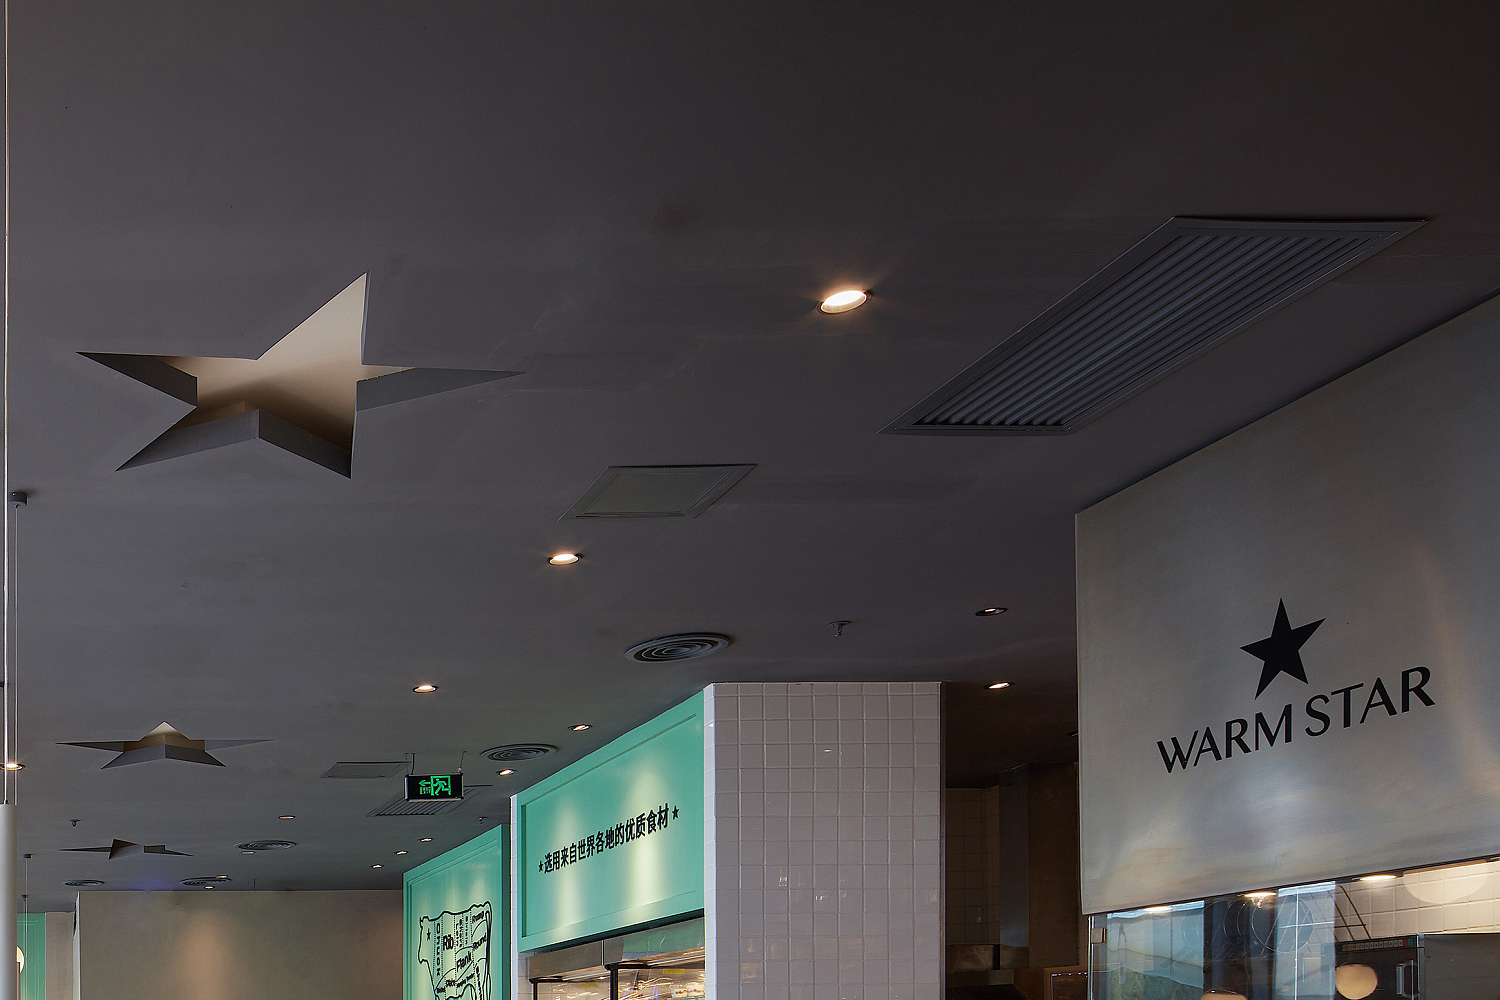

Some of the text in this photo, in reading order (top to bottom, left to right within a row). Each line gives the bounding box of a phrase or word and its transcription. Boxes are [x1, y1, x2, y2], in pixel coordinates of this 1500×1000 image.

[1156, 666, 1436, 774] WARM STAR
[544, 803, 669, 874] 选用来自世界各地的优质食材
